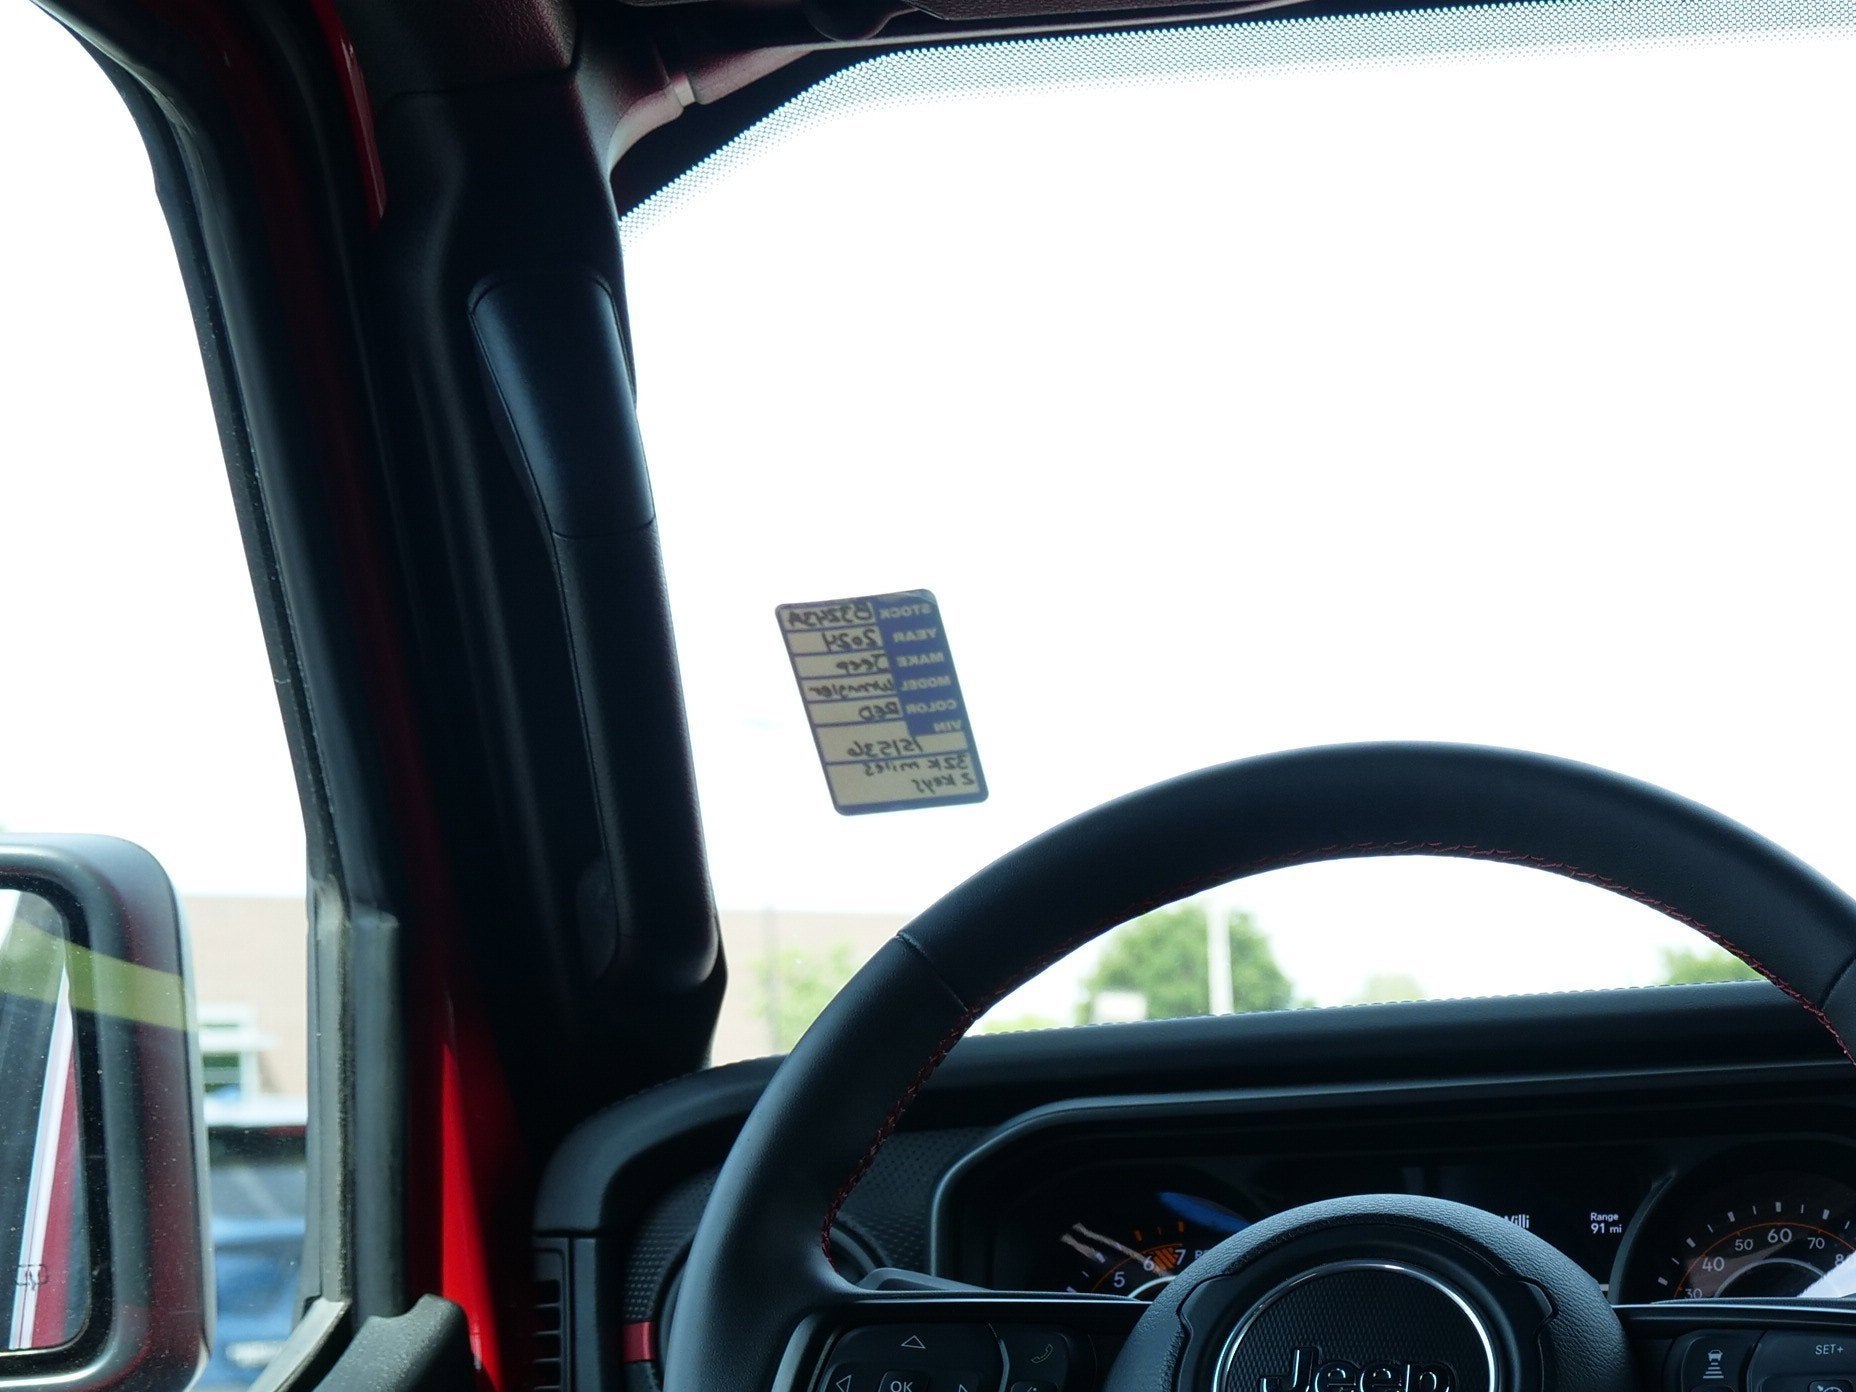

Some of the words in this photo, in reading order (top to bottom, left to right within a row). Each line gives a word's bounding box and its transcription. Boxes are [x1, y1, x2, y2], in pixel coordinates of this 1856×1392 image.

[1590, 1212, 1619, 1222] Range
[1590, 1223, 1605, 1234] 91
[1609, 1224, 1622, 1234] mi
[1767, 1227, 1793, 1245] 60
[1734, 1237, 1754, 1251] 50
[1807, 1237, 1826, 1250] 70
[1143, 1255, 1154, 1271] 6
[1174, 1249, 1186, 1265] 7
[1702, 1256, 1725, 1272] 40
[1113, 1271, 1126, 1288] 5
[1685, 1287, 1702, 1299] 30
